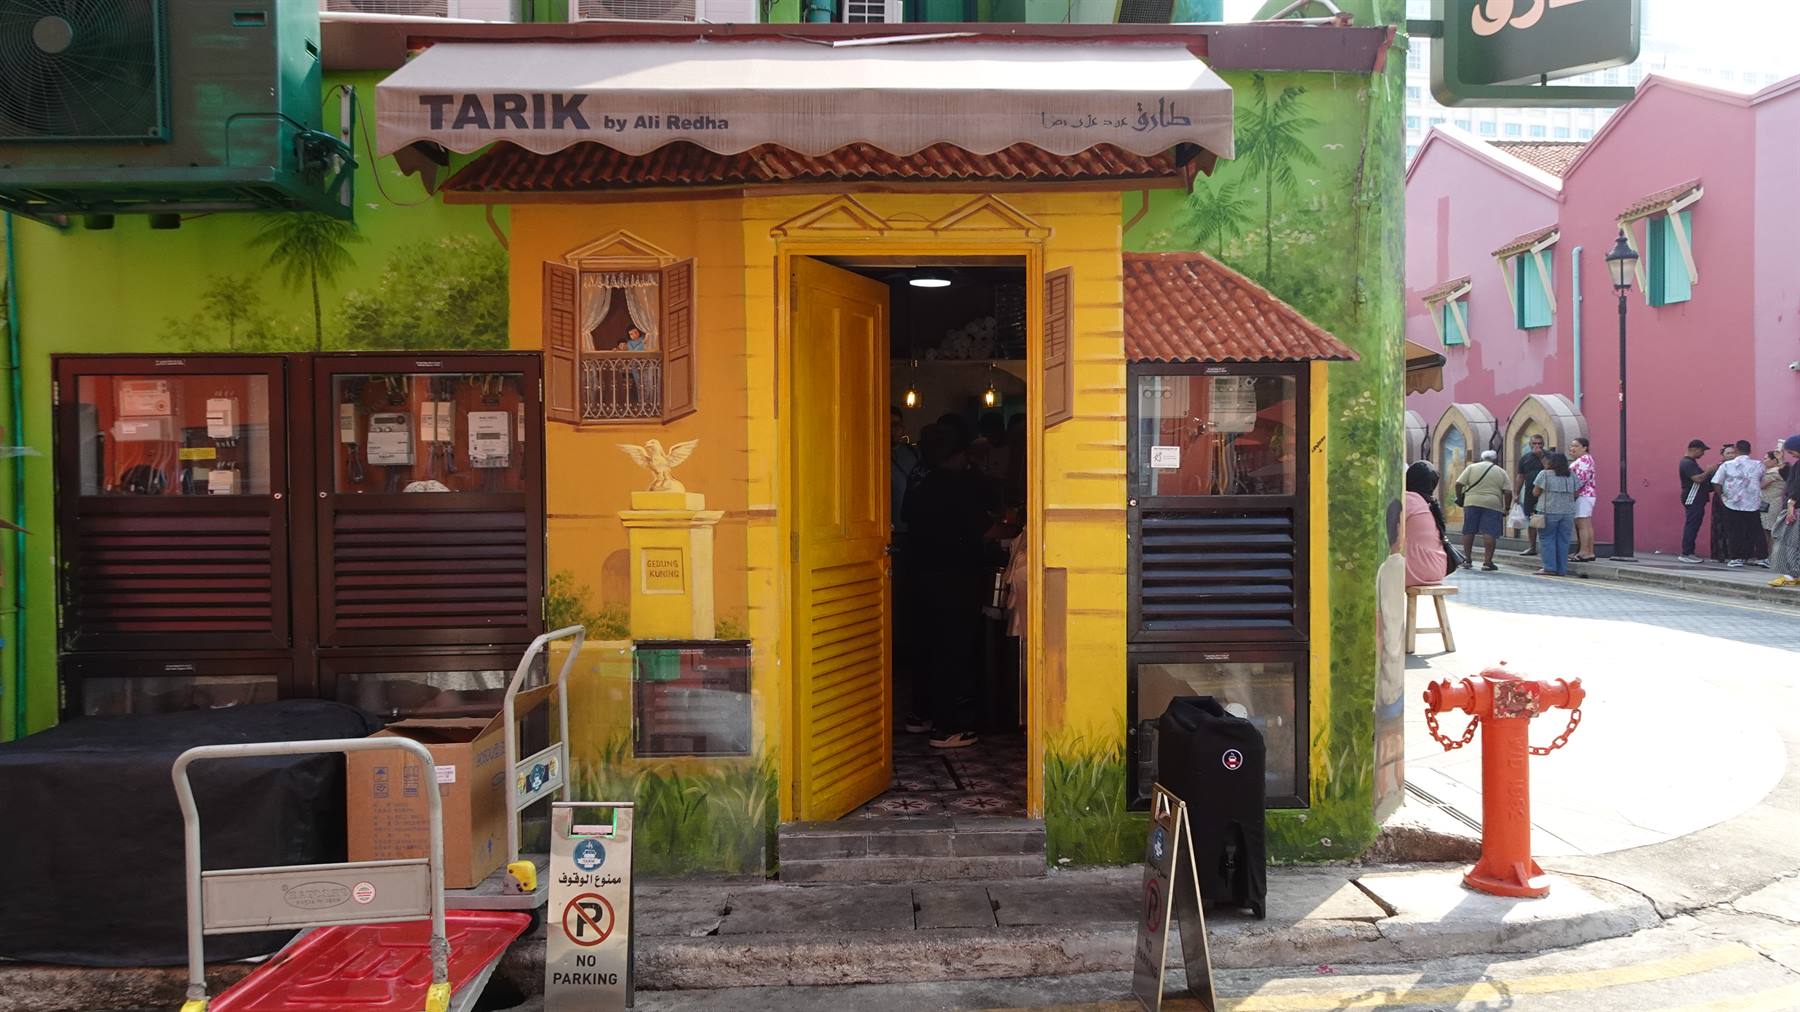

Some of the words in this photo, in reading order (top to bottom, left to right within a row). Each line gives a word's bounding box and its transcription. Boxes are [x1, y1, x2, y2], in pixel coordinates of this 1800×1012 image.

[419, 93, 590, 130] TARIK
[604, 115, 627, 132] by
[634, 115, 660, 130] Ali
[666, 115, 729, 131] Redha
[558, 872, 593, 888] الوقوف
[594, 873, 622, 888] ممنوع
[576, 955, 597, 967] NO
[553, 972, 618, 985] PARKING
